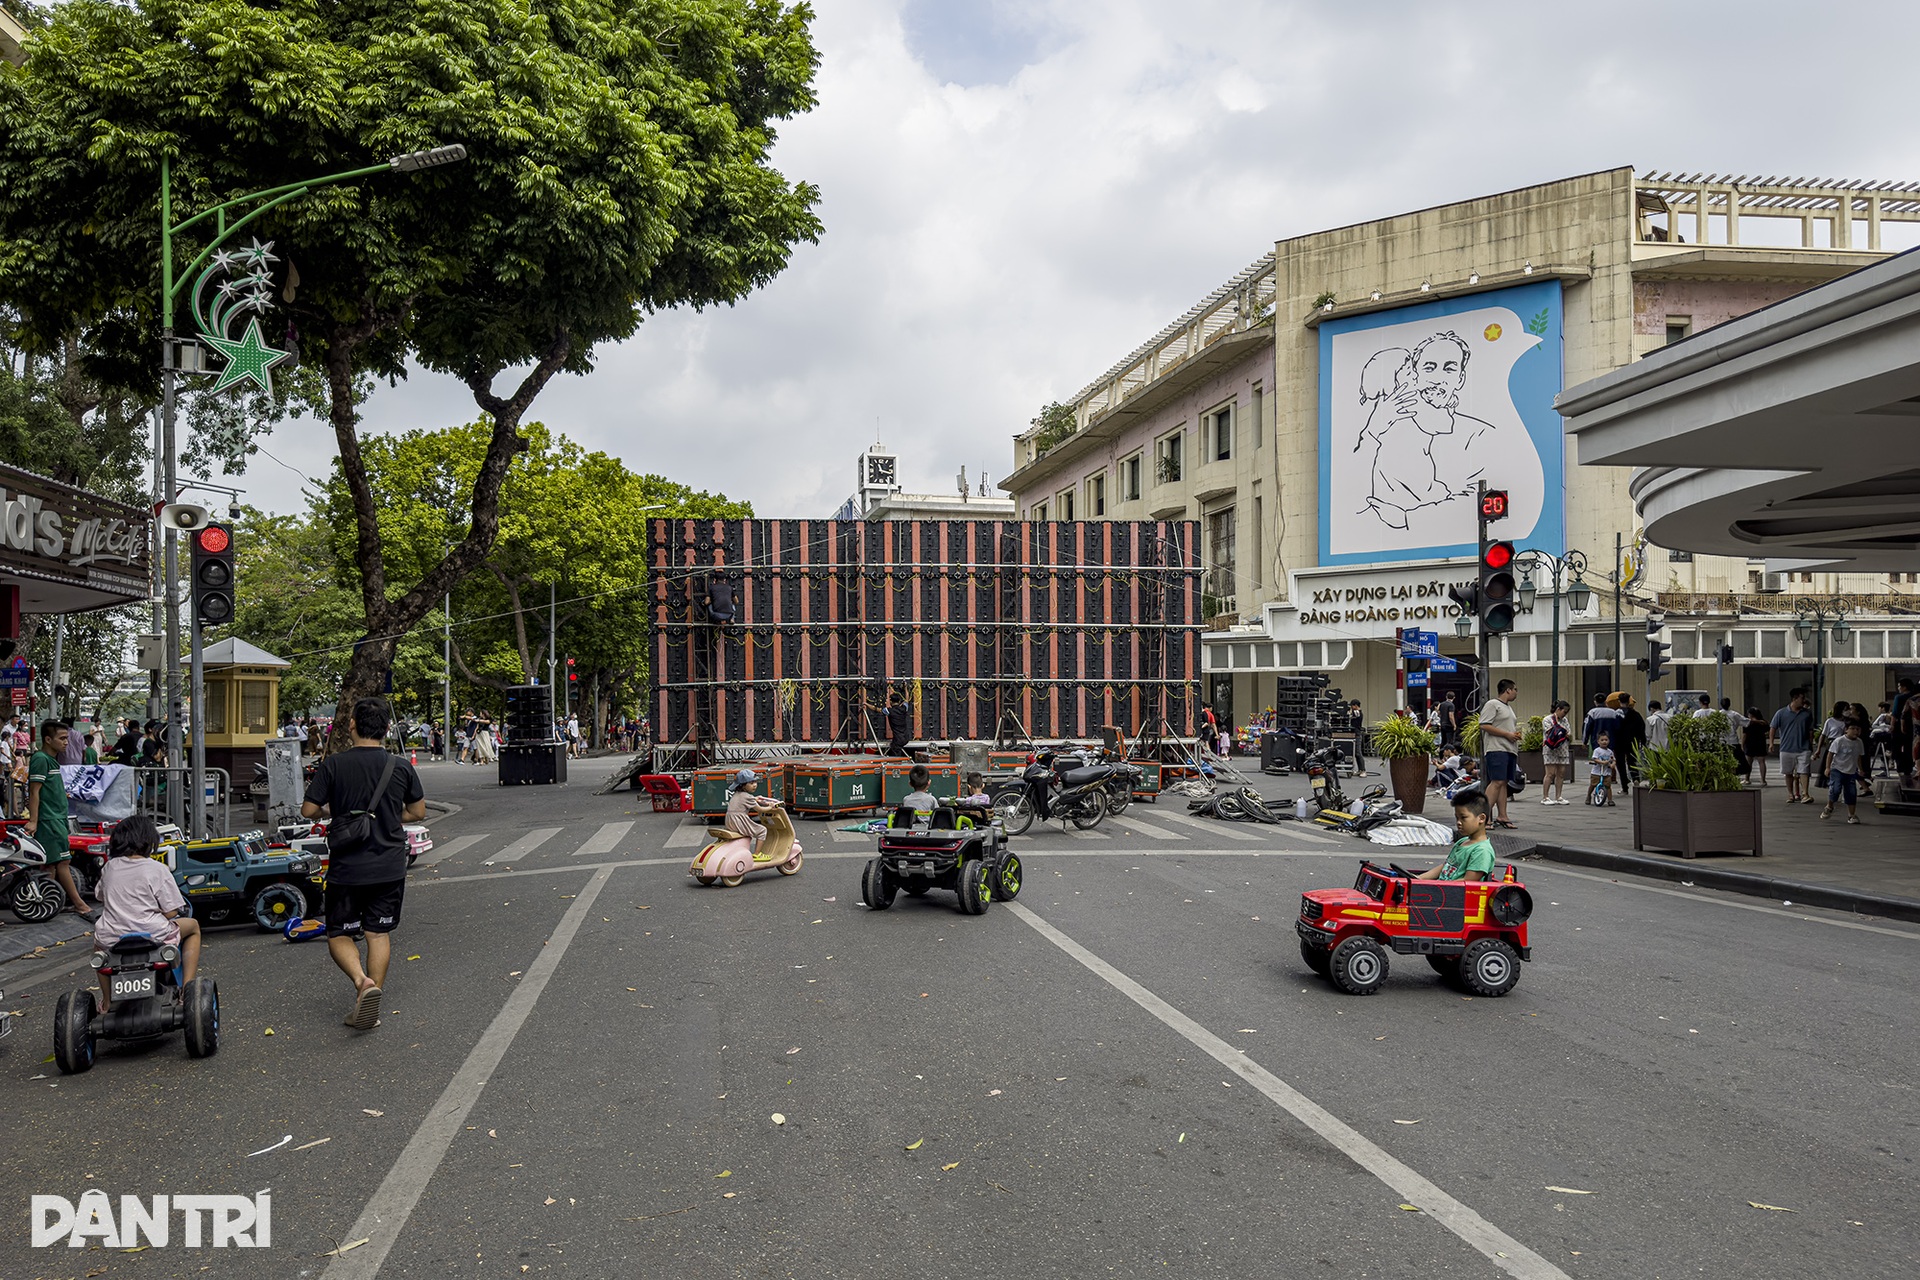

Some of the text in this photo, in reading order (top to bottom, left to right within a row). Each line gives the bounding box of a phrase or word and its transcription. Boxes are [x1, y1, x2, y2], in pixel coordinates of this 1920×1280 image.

[1482, 497, 1504, 514] 20
[1313, 588, 1342, 604] XÂY
[1346, 586, 1387, 604] DỰNG
[1391, 585, 1412, 601] LẠI
[1416, 580, 1446, 597] ĐẤT
[1300, 608, 1341, 624] ĐÀNG
[1346, 604, 1400, 622] HOÀNG
[1404, 605, 1438, 620] HƠN
[115, 978, 151, 994] 900S
